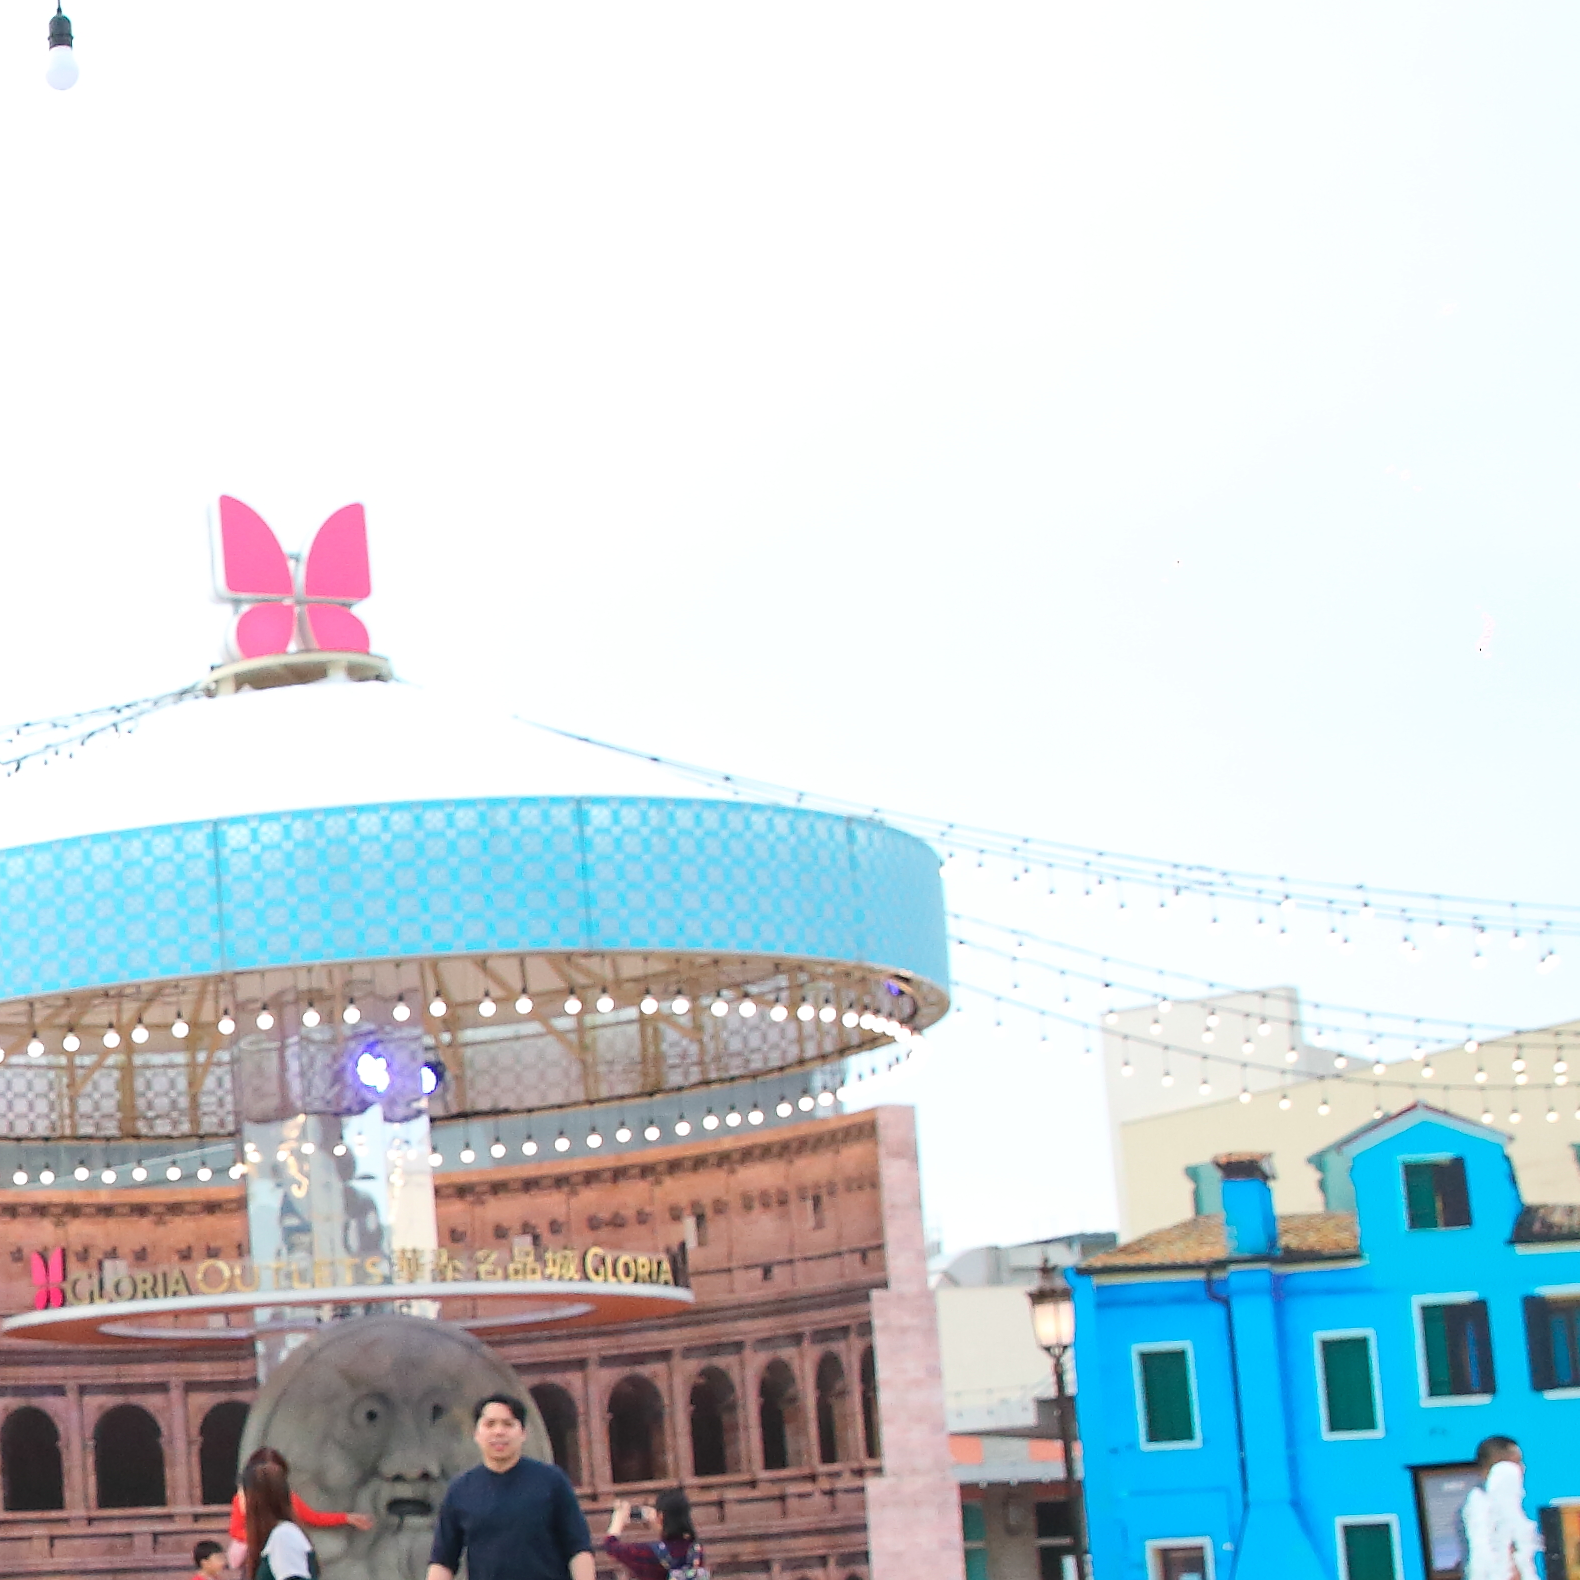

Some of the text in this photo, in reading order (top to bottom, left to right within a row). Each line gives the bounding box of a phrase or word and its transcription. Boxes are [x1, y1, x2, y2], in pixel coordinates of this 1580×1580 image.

[64, 1255, 384, 1306] GLORIA OUTLETS
[584, 1245, 675, 1286] GLORIA
